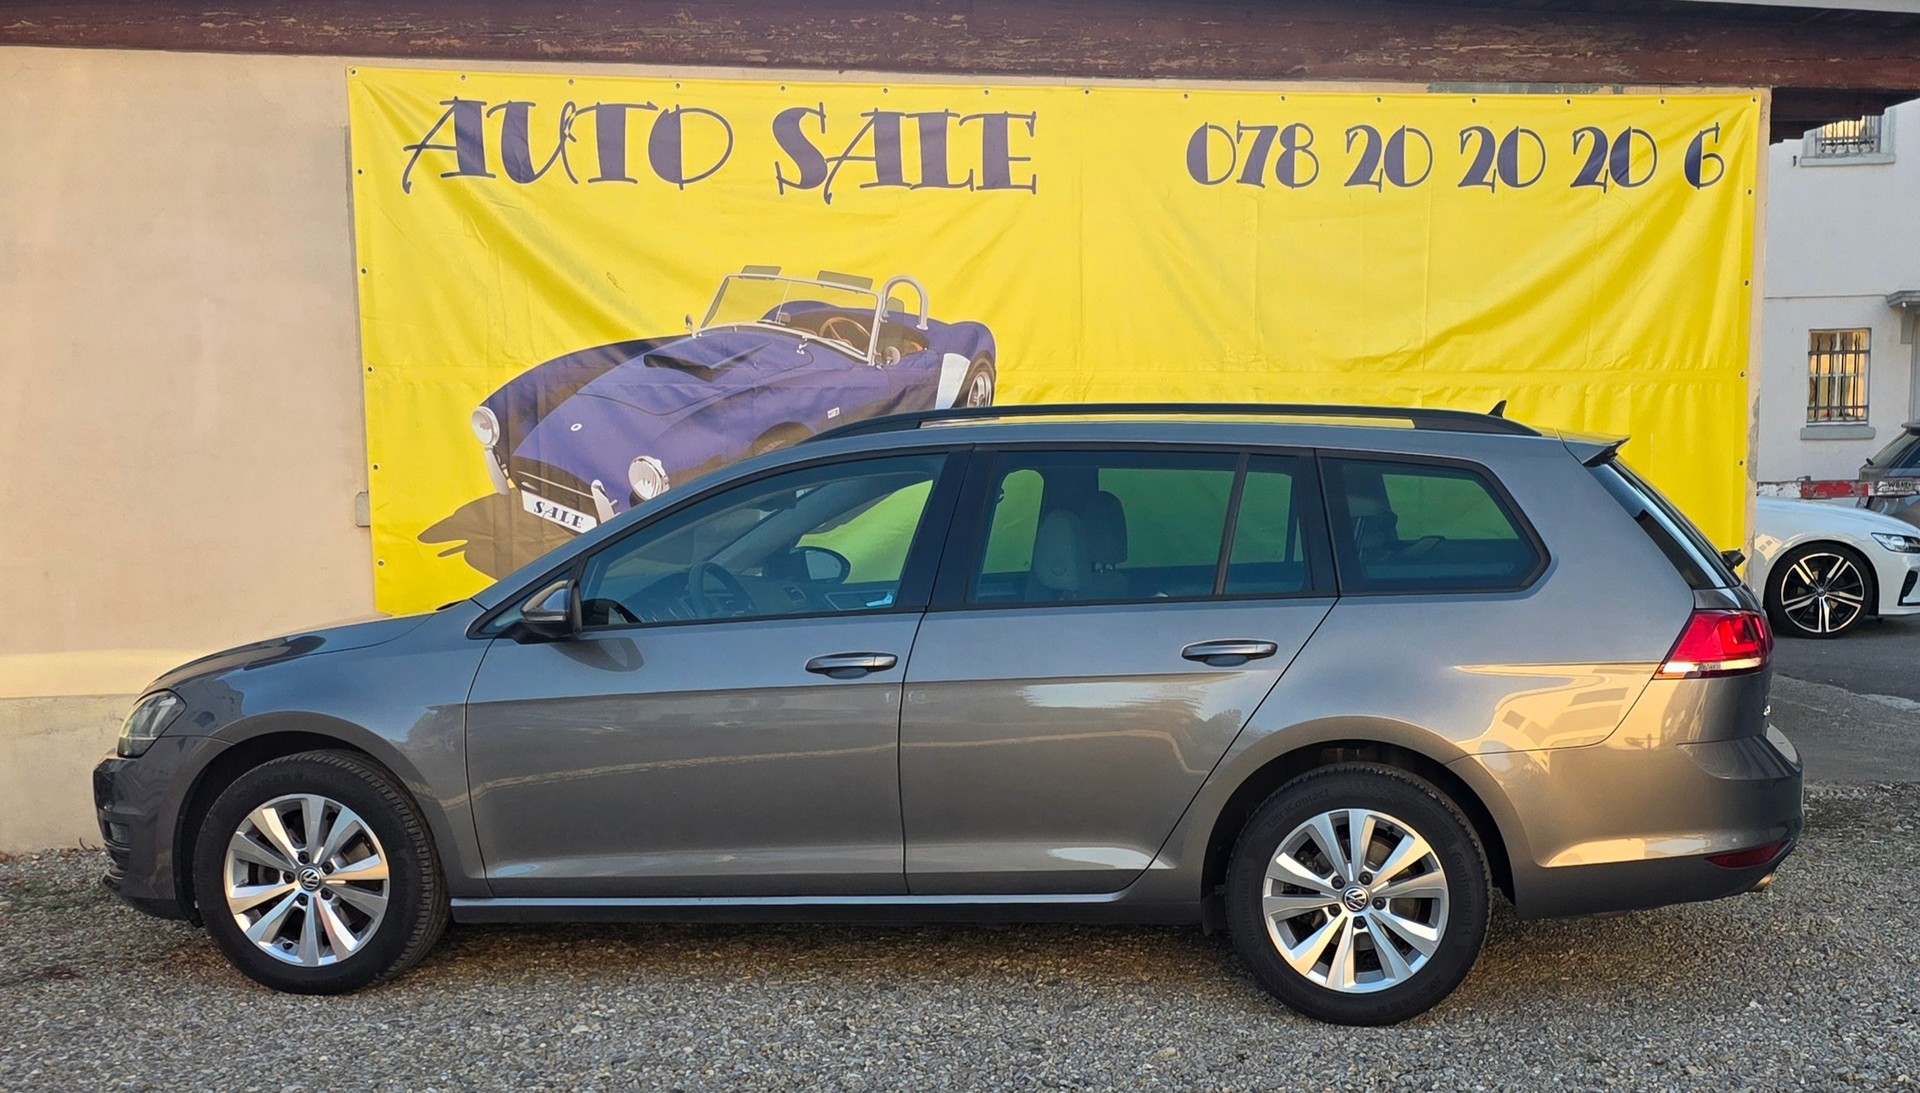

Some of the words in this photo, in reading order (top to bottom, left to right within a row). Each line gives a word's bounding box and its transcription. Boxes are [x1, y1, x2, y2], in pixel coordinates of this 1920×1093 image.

[402, 96, 735, 193] AUTO
[772, 102, 1037, 205] SALE
[1186, 121, 1319, 190] 078
[1344, 124, 1433, 193] 20
[1458, 124, 1546, 194] 20
[1571, 124, 1658, 194] 20
[1684, 121, 1726, 191] 6
[533, 500, 584, 529] SALE
